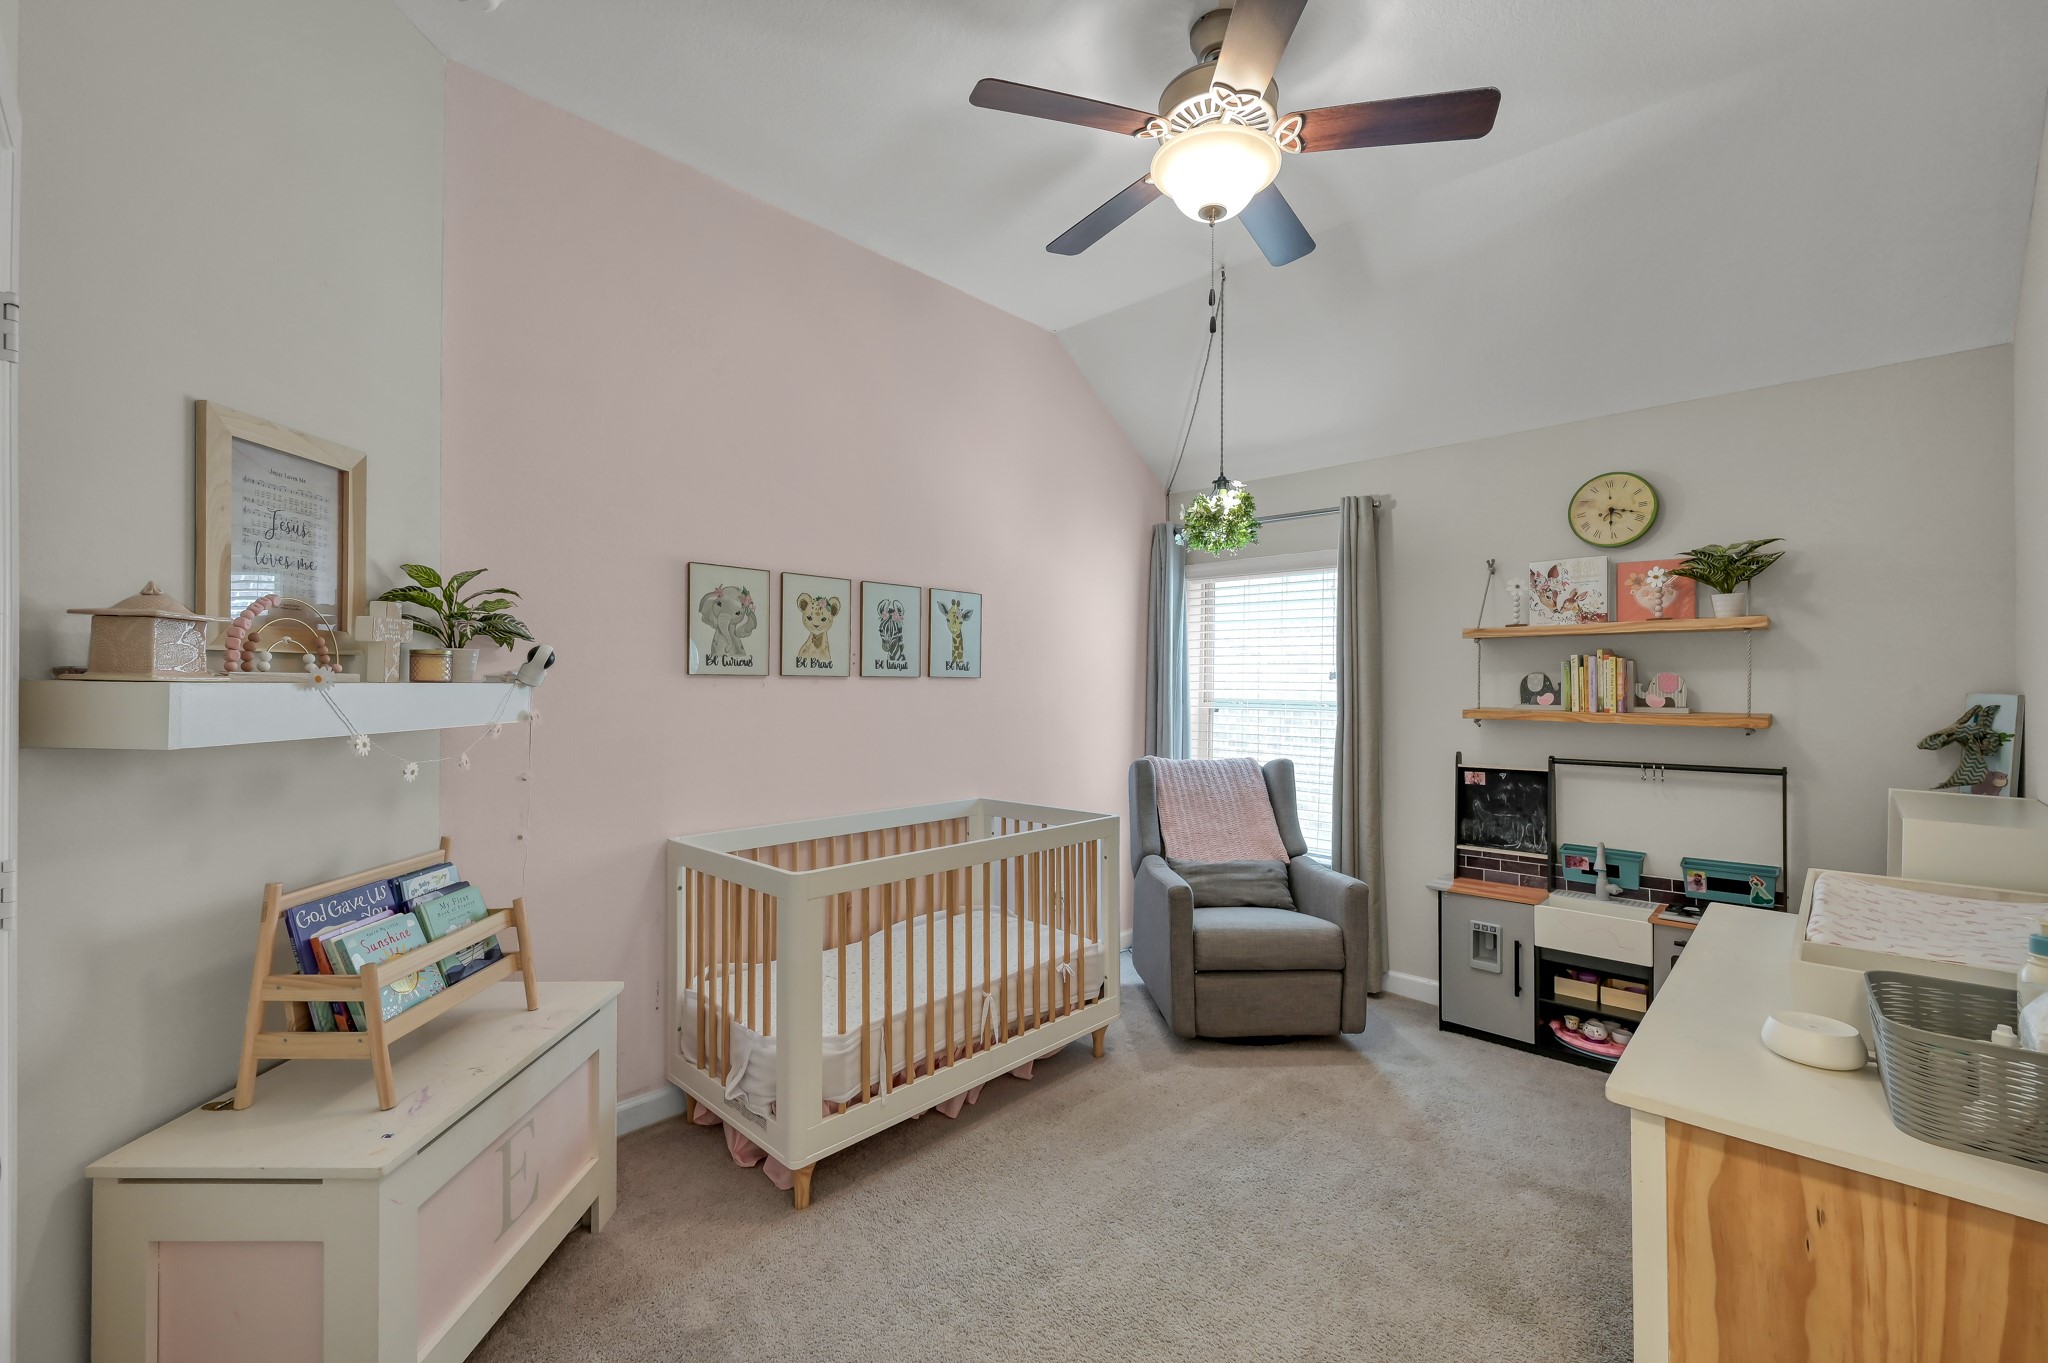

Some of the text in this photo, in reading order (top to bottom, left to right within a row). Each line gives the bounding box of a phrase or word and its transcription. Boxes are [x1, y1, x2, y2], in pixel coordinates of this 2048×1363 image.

[264, 507, 310, 540] Jesus
[255, 540, 318, 571] loves me
[705, 653, 754, 668] Be Curious
[795, 656, 834, 670] Be Brave
[875, 659, 909, 672] Be Unique
[945, 660, 971, 672] Be Kind
[295, 885, 388, 929] God Gave Us
[439, 895, 470, 911] My First
[360, 928, 412, 955] Sunshine
[494, 1117, 541, 1244] E
